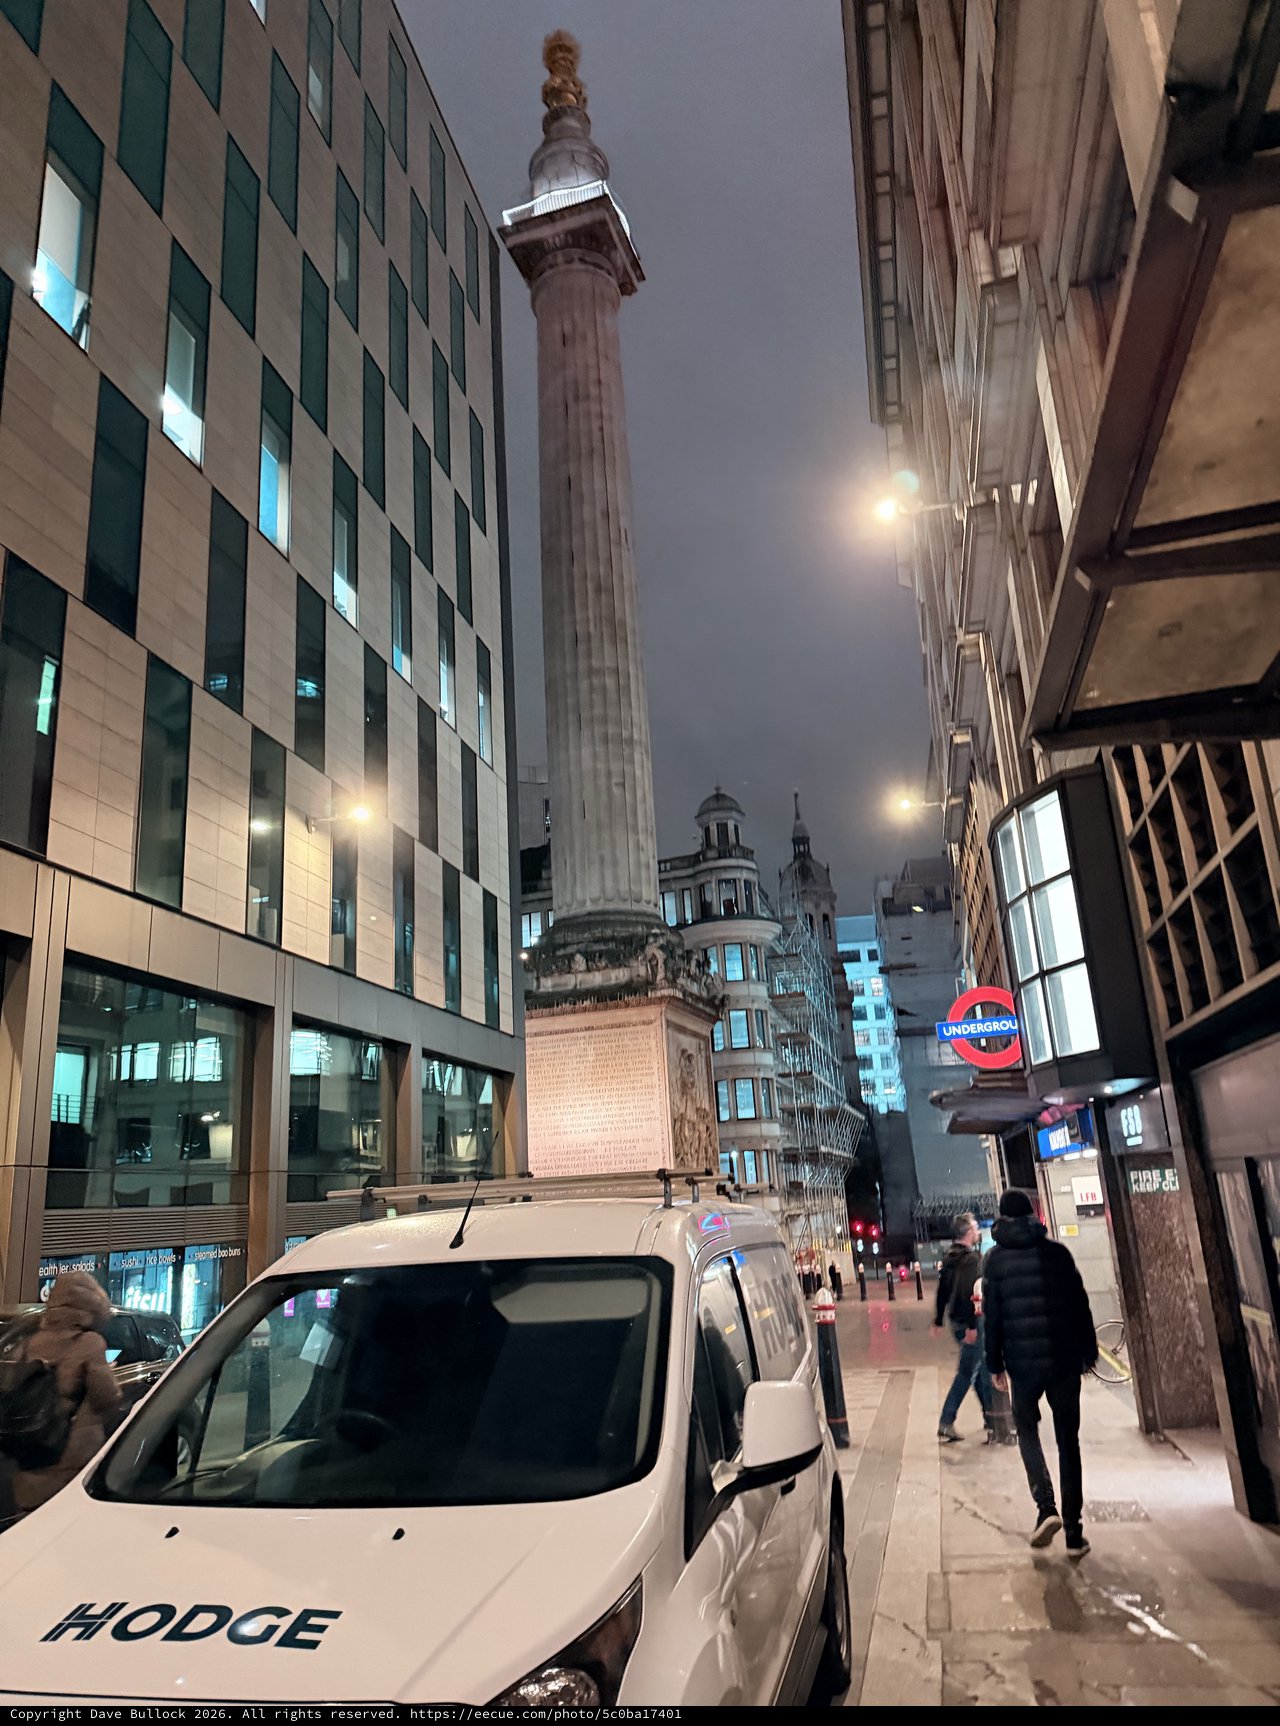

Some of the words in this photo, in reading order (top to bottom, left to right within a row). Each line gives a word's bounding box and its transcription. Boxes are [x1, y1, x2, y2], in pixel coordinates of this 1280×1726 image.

[1130, 1170, 1161, 1183] FIRE
[1165, 1168, 1178, 1181] E
[1132, 1179, 1159, 1193] KEEP
[146, 1255, 157, 1265] rice
[158, 1254, 176, 1265] bowls
[194, 1250, 217, 1261] steamed
[218, 1248, 228, 1258] bao
[229, 1246, 241, 1257] buns
[72, 1260, 95, 1273] salads
[121, 1256, 139, 1268] sushi
[125, 1286, 166, 1313] itsu
[39, 1602, 343, 1650] HODGE
